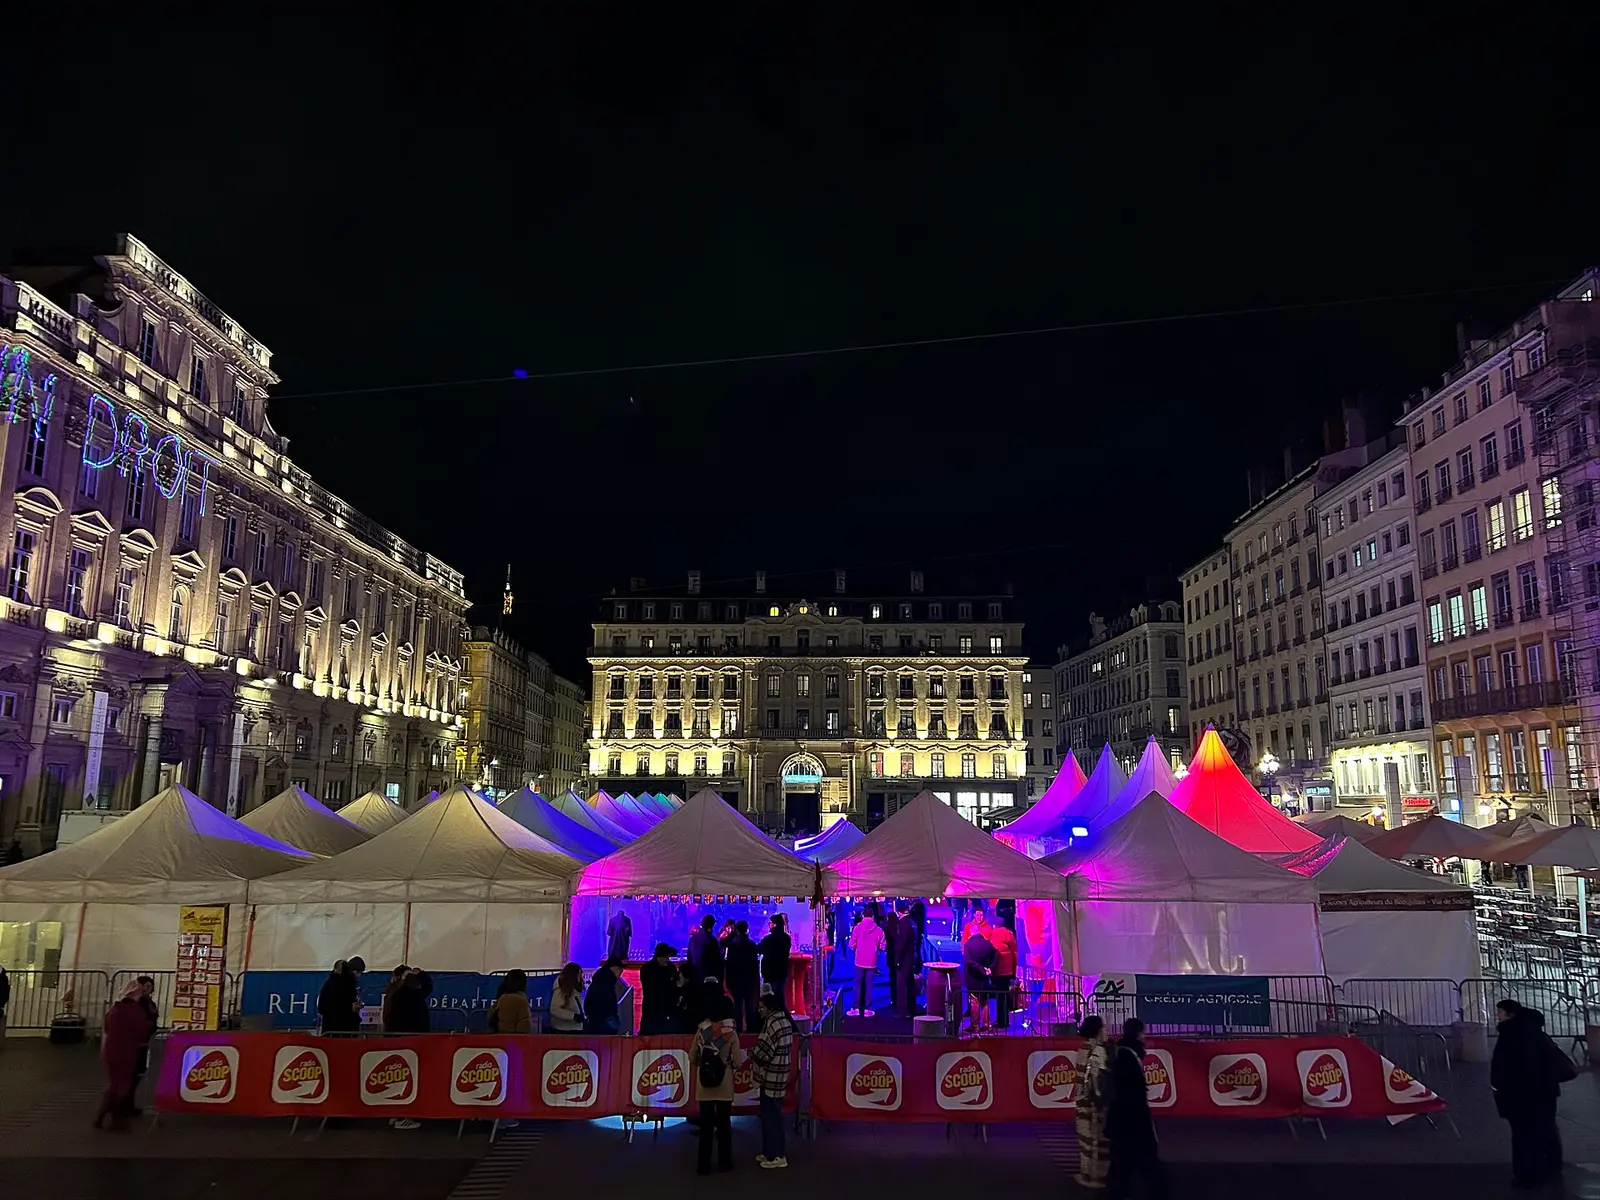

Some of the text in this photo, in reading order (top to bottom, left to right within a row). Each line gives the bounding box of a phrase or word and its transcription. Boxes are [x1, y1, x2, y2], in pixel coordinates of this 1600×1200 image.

[82, 393, 223, 517] DROIT
[206, 1060, 223, 1068] radio
[300, 1059, 316, 1067] radio
[385, 1061, 402, 1070] radio
[475, 1061, 493, 1070] radio
[566, 1063, 583, 1071] radio
[657, 1062, 675, 1071] radio
[959, 1064, 976, 1073] radio
[1051, 1064, 1069, 1072] radio
[1143, 1062, 1159, 1071] radio
[1319, 1062, 1334, 1072] radio
[190, 1065, 230, 1082] SCOOP
[282, 1066, 322, 1082] SCOOP
[369, 1067, 410, 1085] SCOOP
[461, 1068, 499, 1084] SCOOP
[1145, 1068, 1166, 1084] OOP
[1234, 1066, 1251, 1074] radio
[551, 1069, 591, 1085] SCOOP
[641, 1069, 682, 1087] SCOOP
[855, 1074, 894, 1088] SCOOP
[945, 1071, 984, 1088] SCOOP
[1037, 1069, 1076, 1087] SCOOP
[1217, 1073, 1260, 1085] SCOOP
[1308, 1068, 1342, 1087] SCOOP
